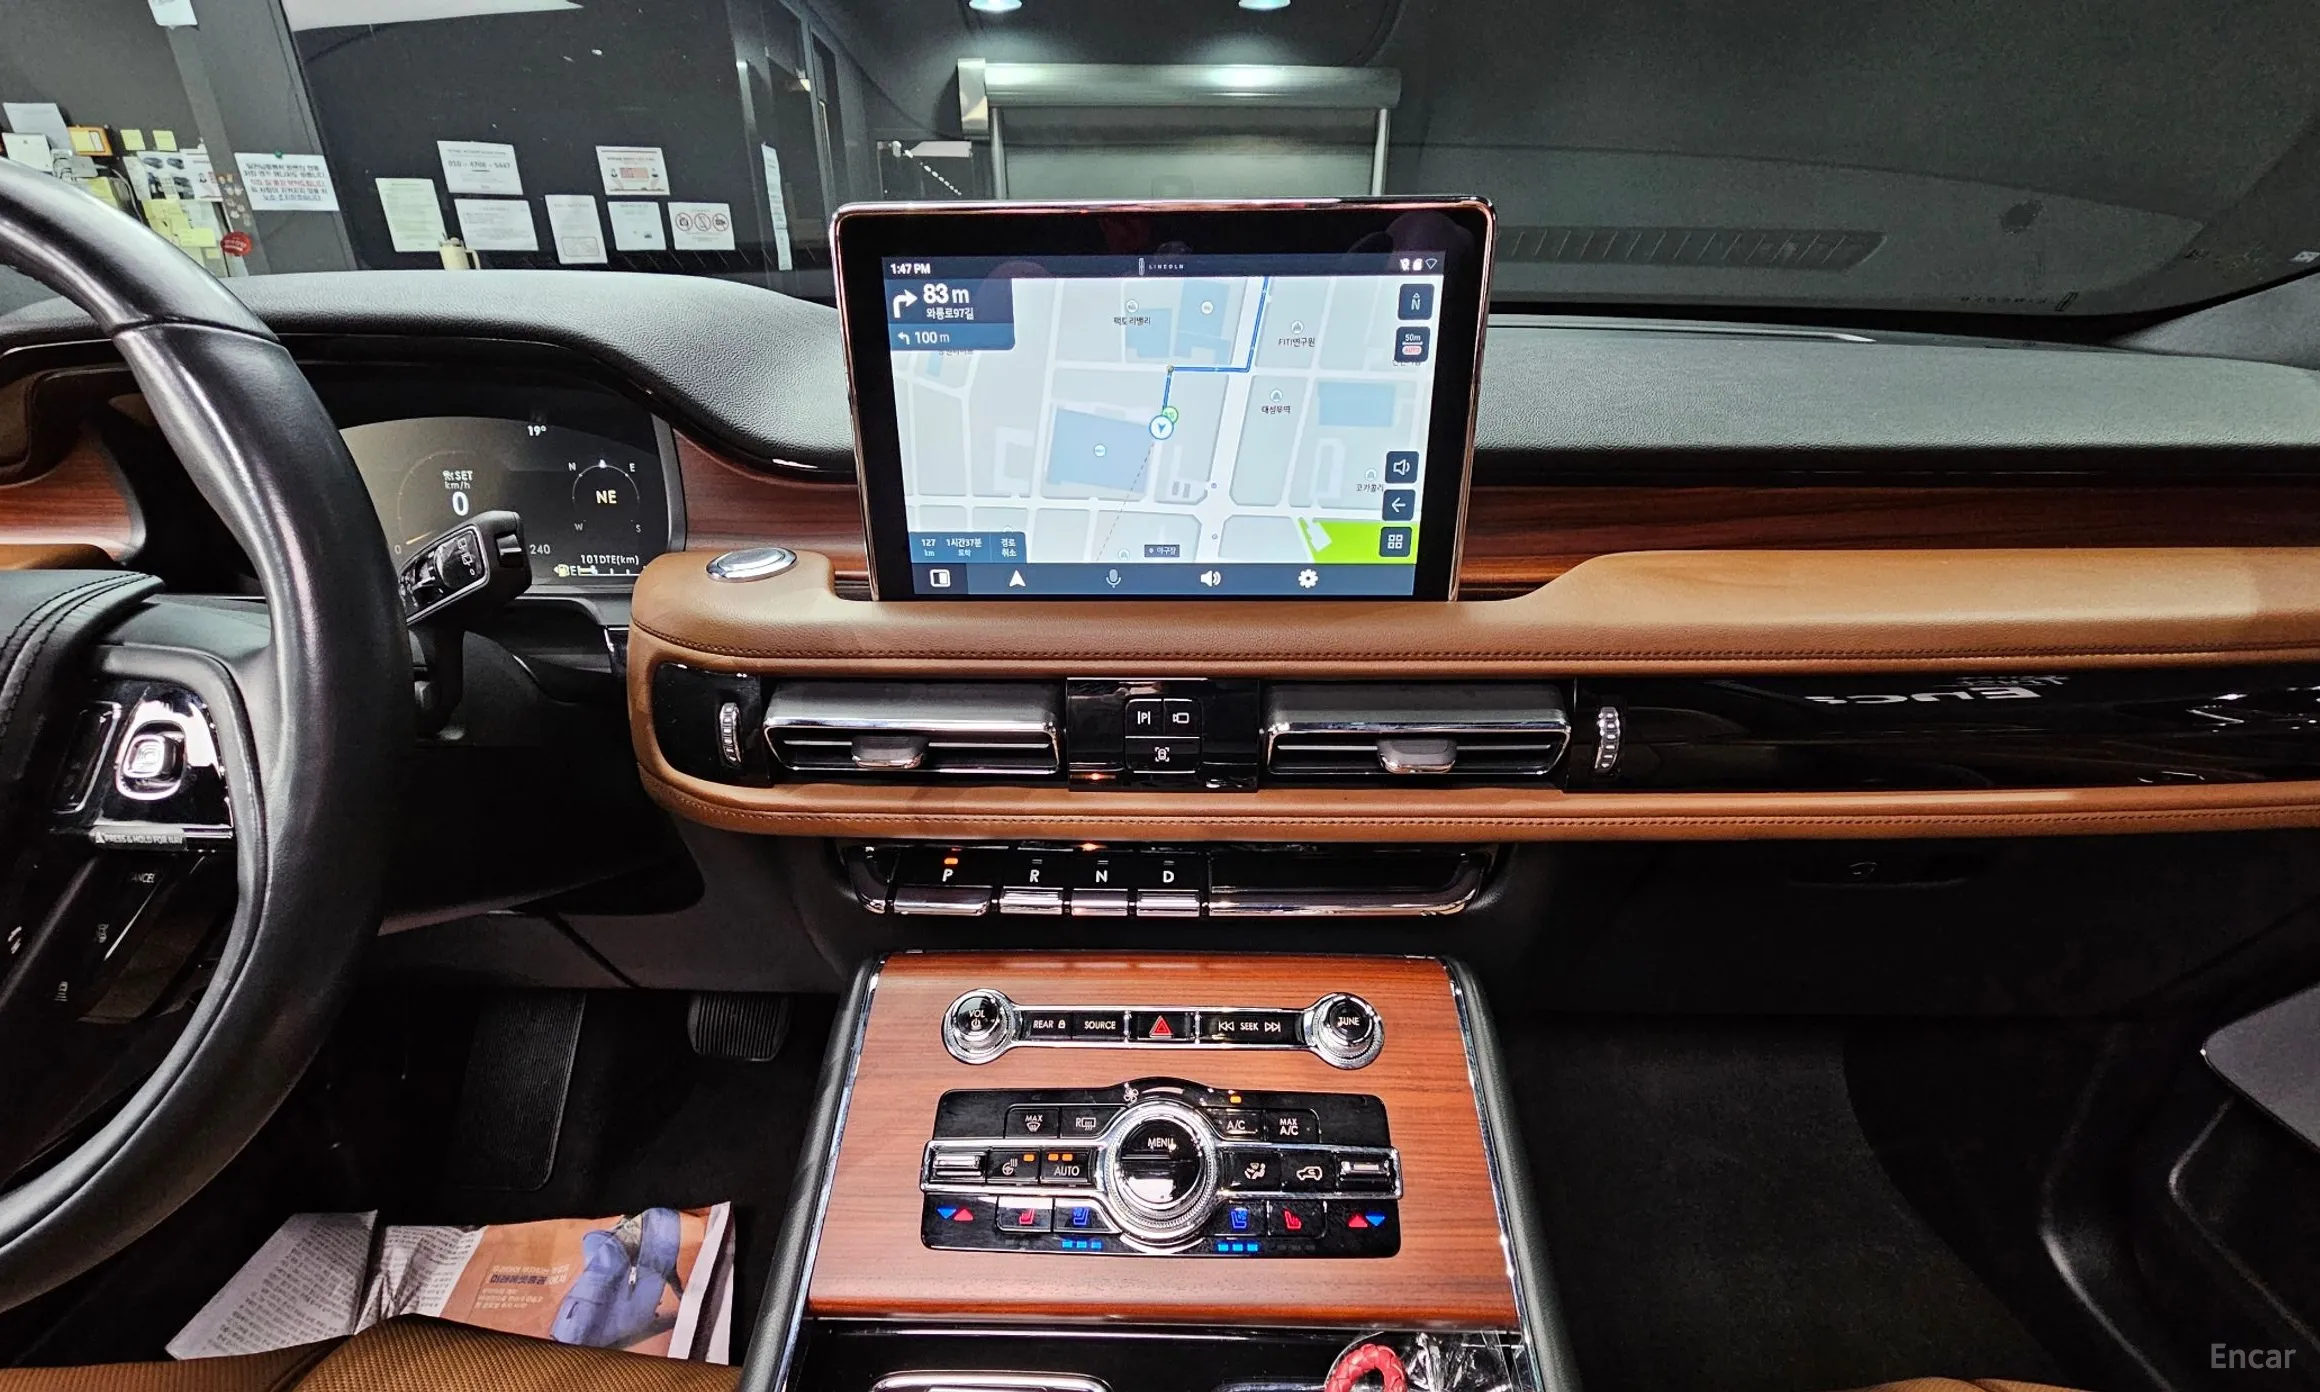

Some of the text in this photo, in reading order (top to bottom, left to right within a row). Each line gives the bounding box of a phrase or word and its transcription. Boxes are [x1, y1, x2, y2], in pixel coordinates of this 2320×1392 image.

[890, 263, 931, 275] 1:47 PM
[1148, 263, 1185, 271] LINCOLN
[923, 283, 970, 304] 83 m
[1411, 299, 1421, 311] N
[926, 307, 974, 321] 와룡로97길
[914, 331, 950, 344] 100 m
[1404, 333, 1421, 342] 50m
[568, 461, 576, 472] N
[630, 462, 636, 473] E
[455, 470, 473, 481] SET
[444, 481, 471, 490] km/h
[595, 490, 618, 504] NE
[451, 491, 470, 516] 0
[574, 522, 584, 532] W
[635, 524, 642, 534] S
[921, 537, 983, 548] 127 1시간37분
[1001, 538, 1017, 548] 경로
[394, 544, 402, 555] 0
[530, 543, 551, 555] 240
[923, 549, 935, 557] km
[1001, 548, 1017, 558] 취소
[942, 869, 955, 883] P
[1029, 869, 1040, 883] R
[1095, 869, 1108, 883] N
[1163, 869, 1175, 883] D
[968, 1009, 985, 1019] VOL
[1033, 1020, 1054, 1029] REAR
[1084, 1020, 1116, 1031] SOURCE
[1239, 1022, 1259, 1031] SEEK
[1025, 1114, 1043, 1122] MAX
[1279, 1118, 1298, 1126] MAX
[1227, 1120, 1246, 1131] A/C
[1279, 1125, 1299, 1136] A/C
[1148, 1137, 1174, 1148] MENU
[1054, 1165, 1080, 1177] AUTO
